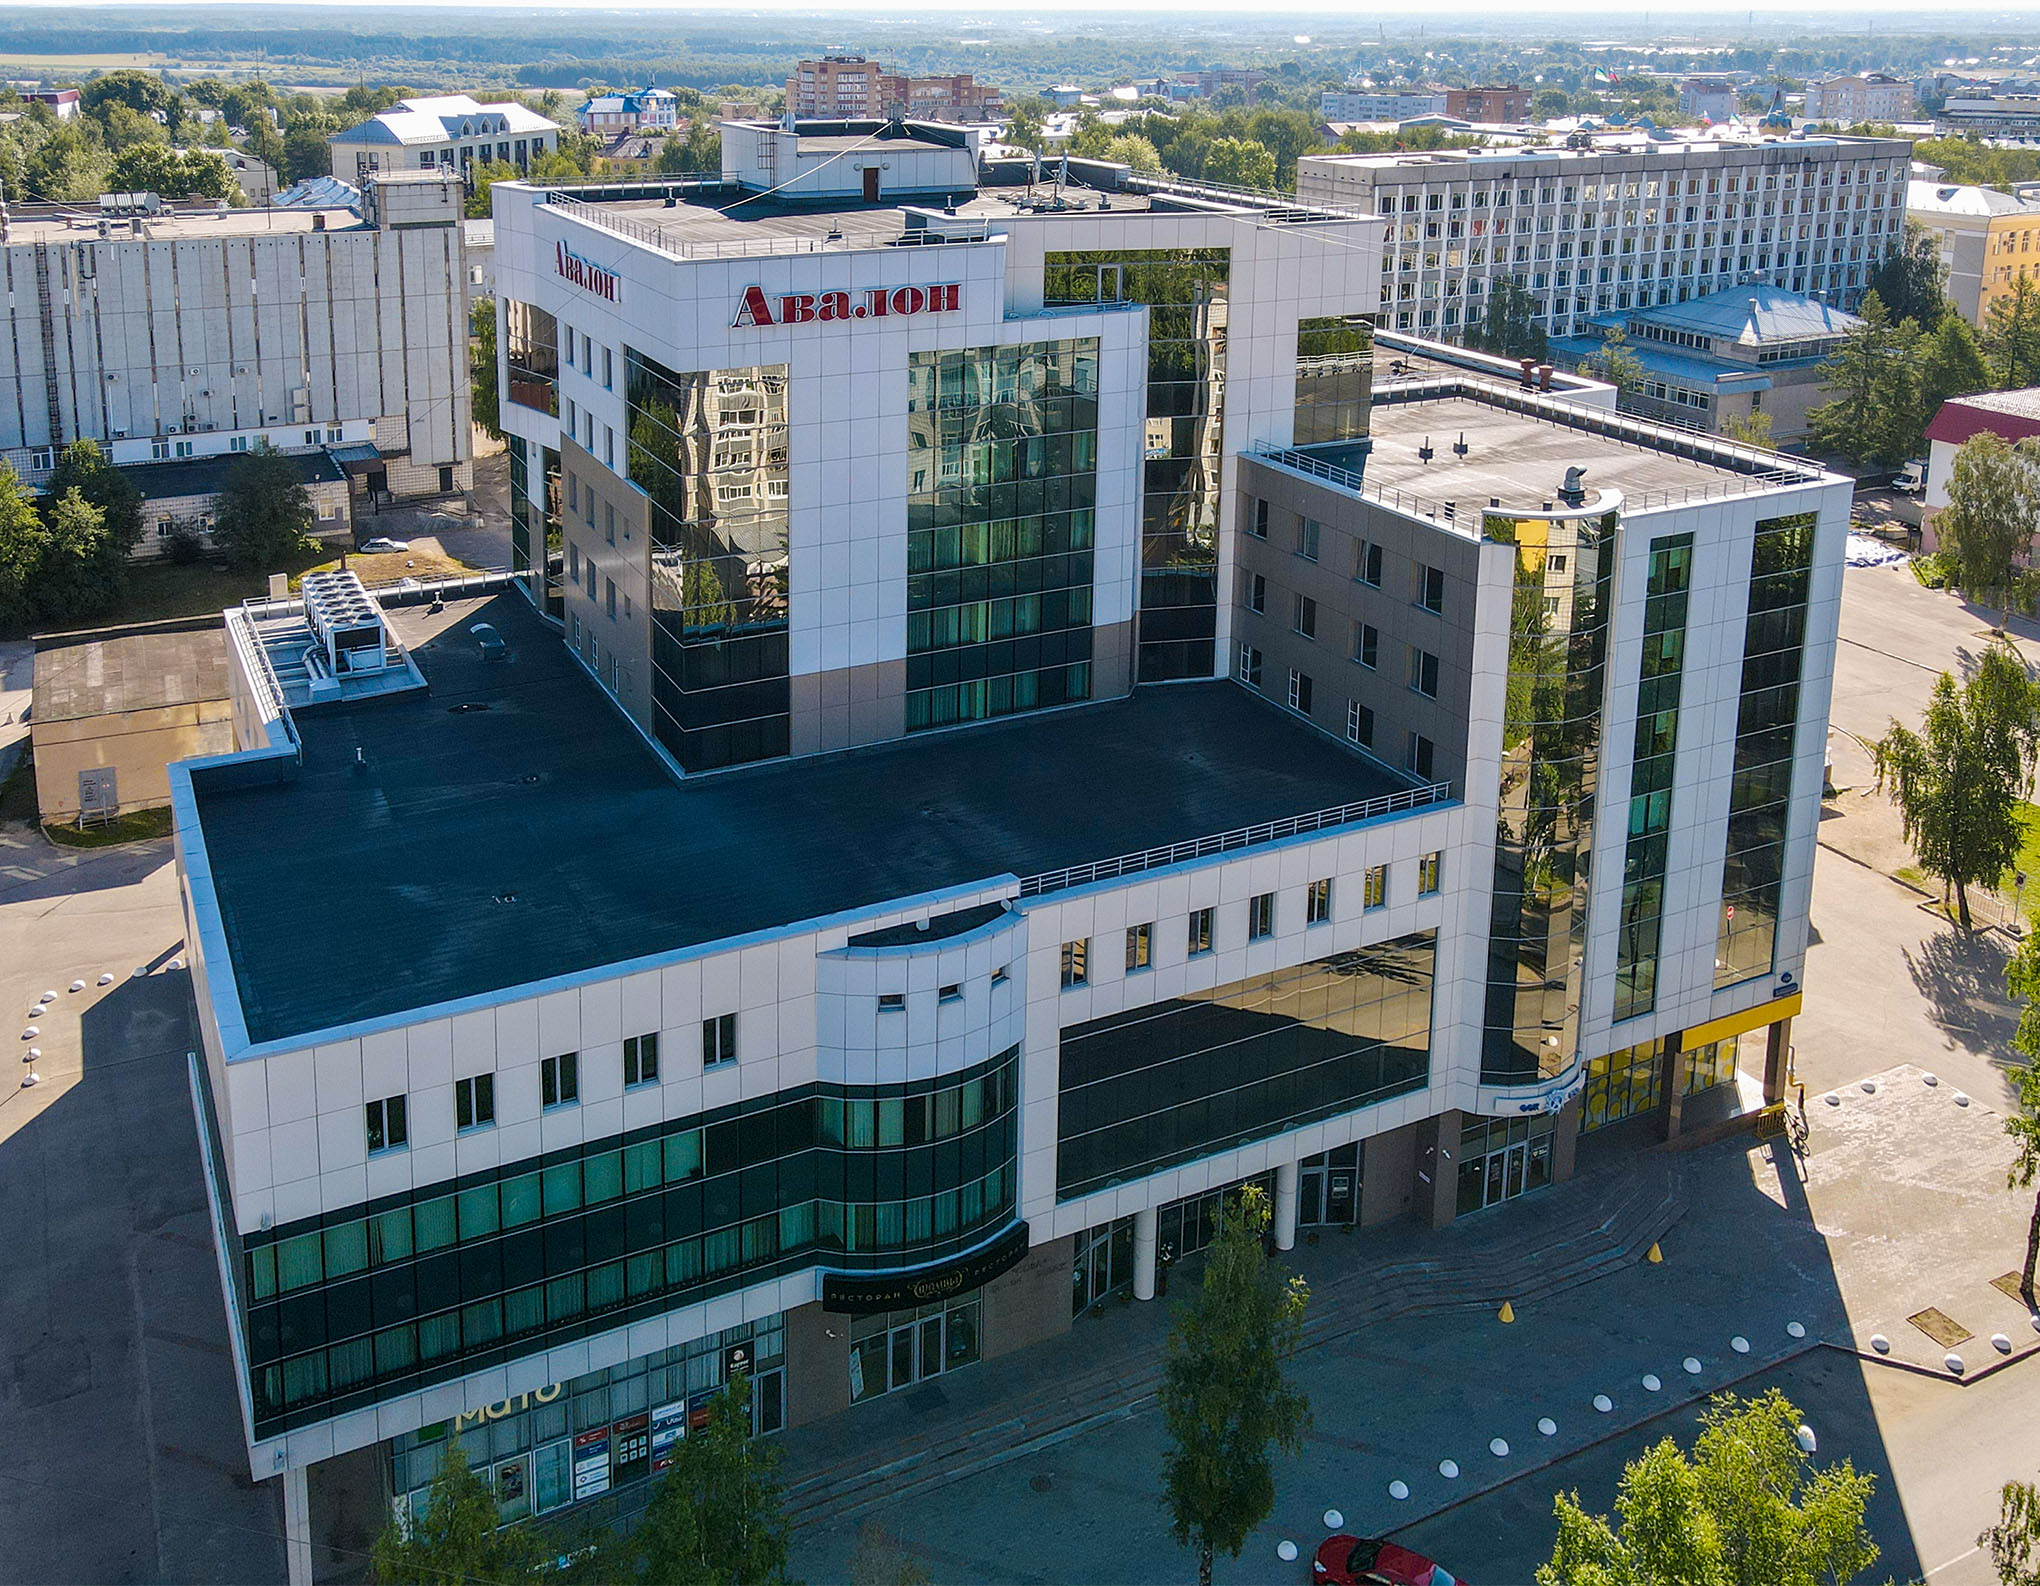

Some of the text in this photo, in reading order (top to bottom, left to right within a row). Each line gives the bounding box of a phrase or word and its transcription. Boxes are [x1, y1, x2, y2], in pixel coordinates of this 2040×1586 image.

[553, 240, 621, 303] Авалон
[730, 283, 962, 329] Авалон
[830, 1291, 901, 1302] РЕСТОРАН
